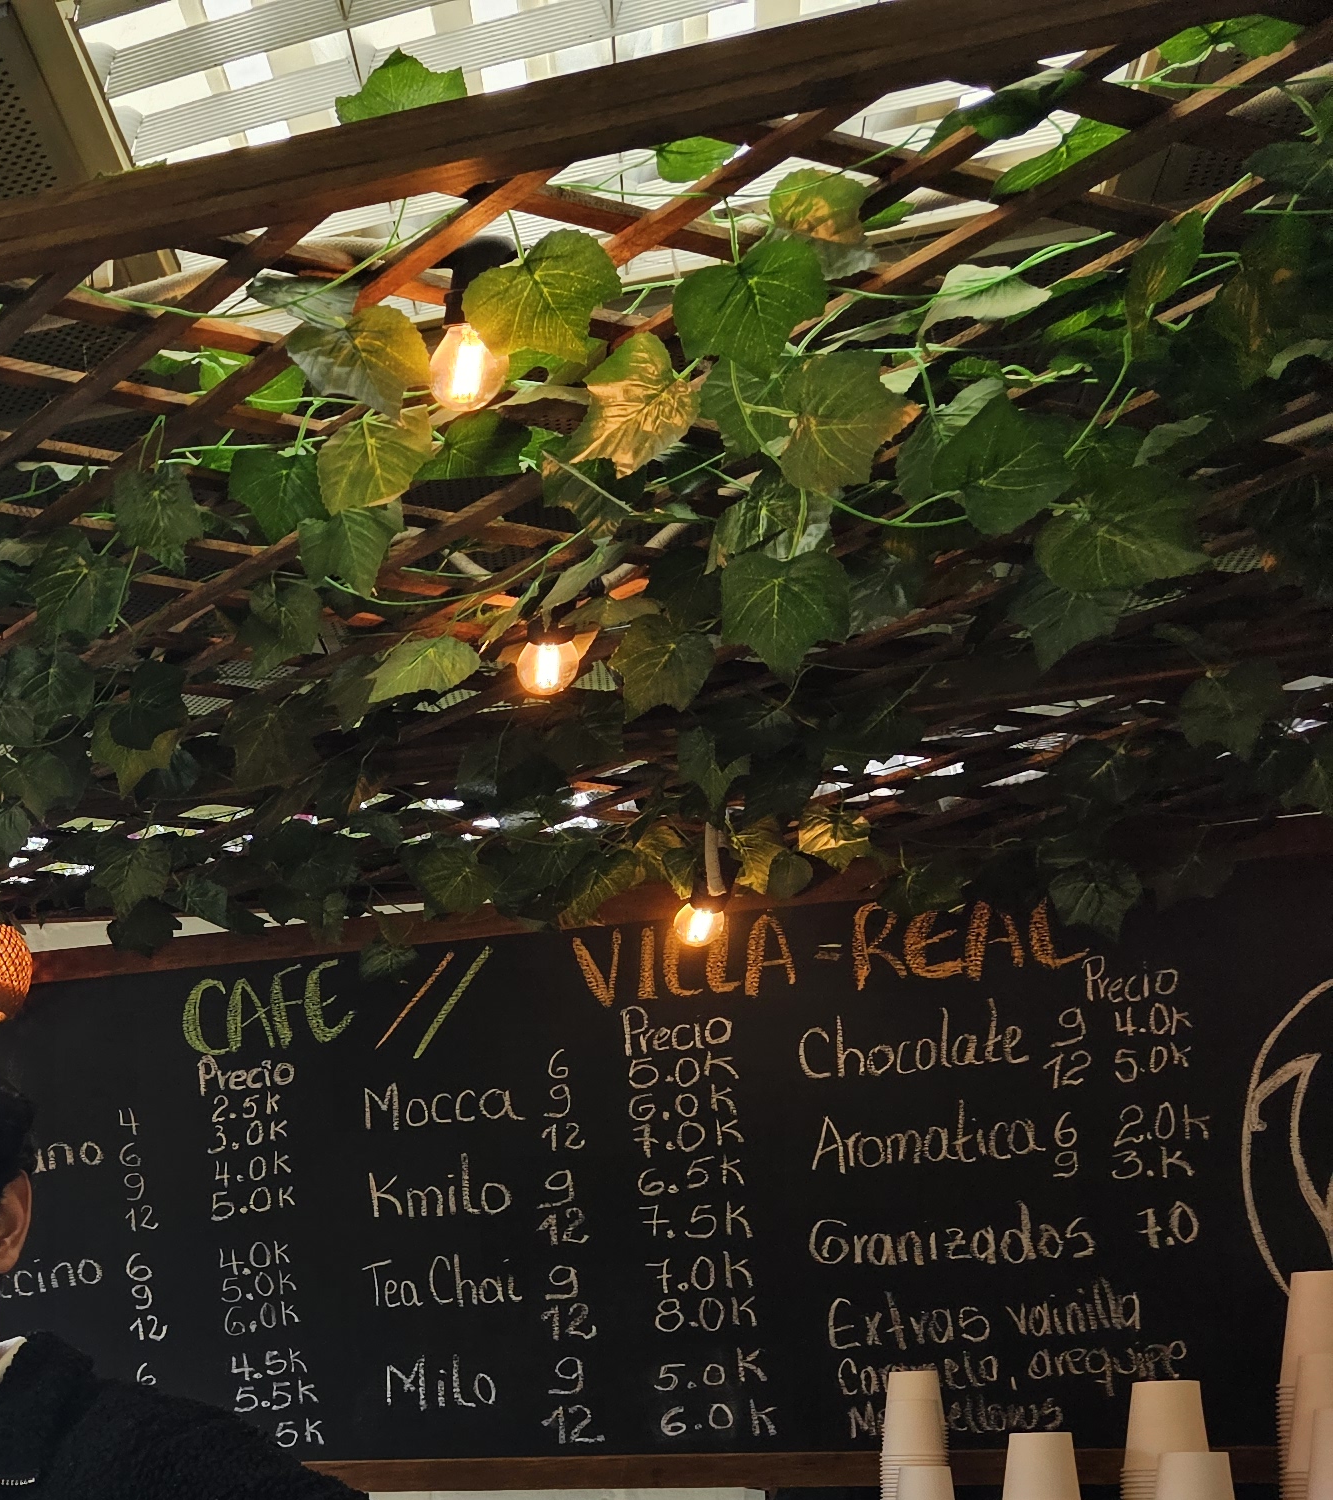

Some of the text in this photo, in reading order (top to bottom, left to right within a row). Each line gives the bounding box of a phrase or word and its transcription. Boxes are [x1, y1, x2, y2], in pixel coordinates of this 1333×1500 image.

[1083, 957, 1180, 1002] Precio
[182, 959, 355, 1054] CAFE
[620, 1006, 732, 1056] Precio
[799, 998, 1028, 1079] Chocolate
[1050, 1006, 1087, 1048] 9
[198, 1056, 295, 1095] Precio
[548, 1049, 569, 1079] 6
[1043, 1049, 1091, 1090] 12
[119, 1108, 139, 1136] 4
[364, 1083, 525, 1130] Mocca
[542, 1084, 572, 1119] 9
[119, 1142, 141, 1167] 6
[543, 1121, 585, 1152] 12
[813, 1101, 1045, 1173] Aromatica
[1053, 1109, 1078, 1145] 6
[1053, 1150, 1079, 1178] 9
[124, 1174, 145, 1200] 9
[540, 1169, 575, 1209] 9
[124, 1205, 159, 1232] 12
[537, 1209, 588, 1246] 12
[810, 1201, 1198, 1265] Granizados 7.0
[125, 1254, 152, 1280] 6
[362, 1260, 423, 1308] Tea
[428, 1254, 523, 1307] Chai
[543, 1266, 579, 1302] 9
[132, 1280, 153, 1308] 9
[130, 1314, 167, 1341] 12
[541, 1305, 597, 1339] 12
[829, 1294, 990, 1350] Extras
[135, 1363, 156, 1386] 6
[386, 1355, 496, 1410] Milo
[548, 1358, 584, 1395] 9
[541, 1403, 605, 1445] 12
